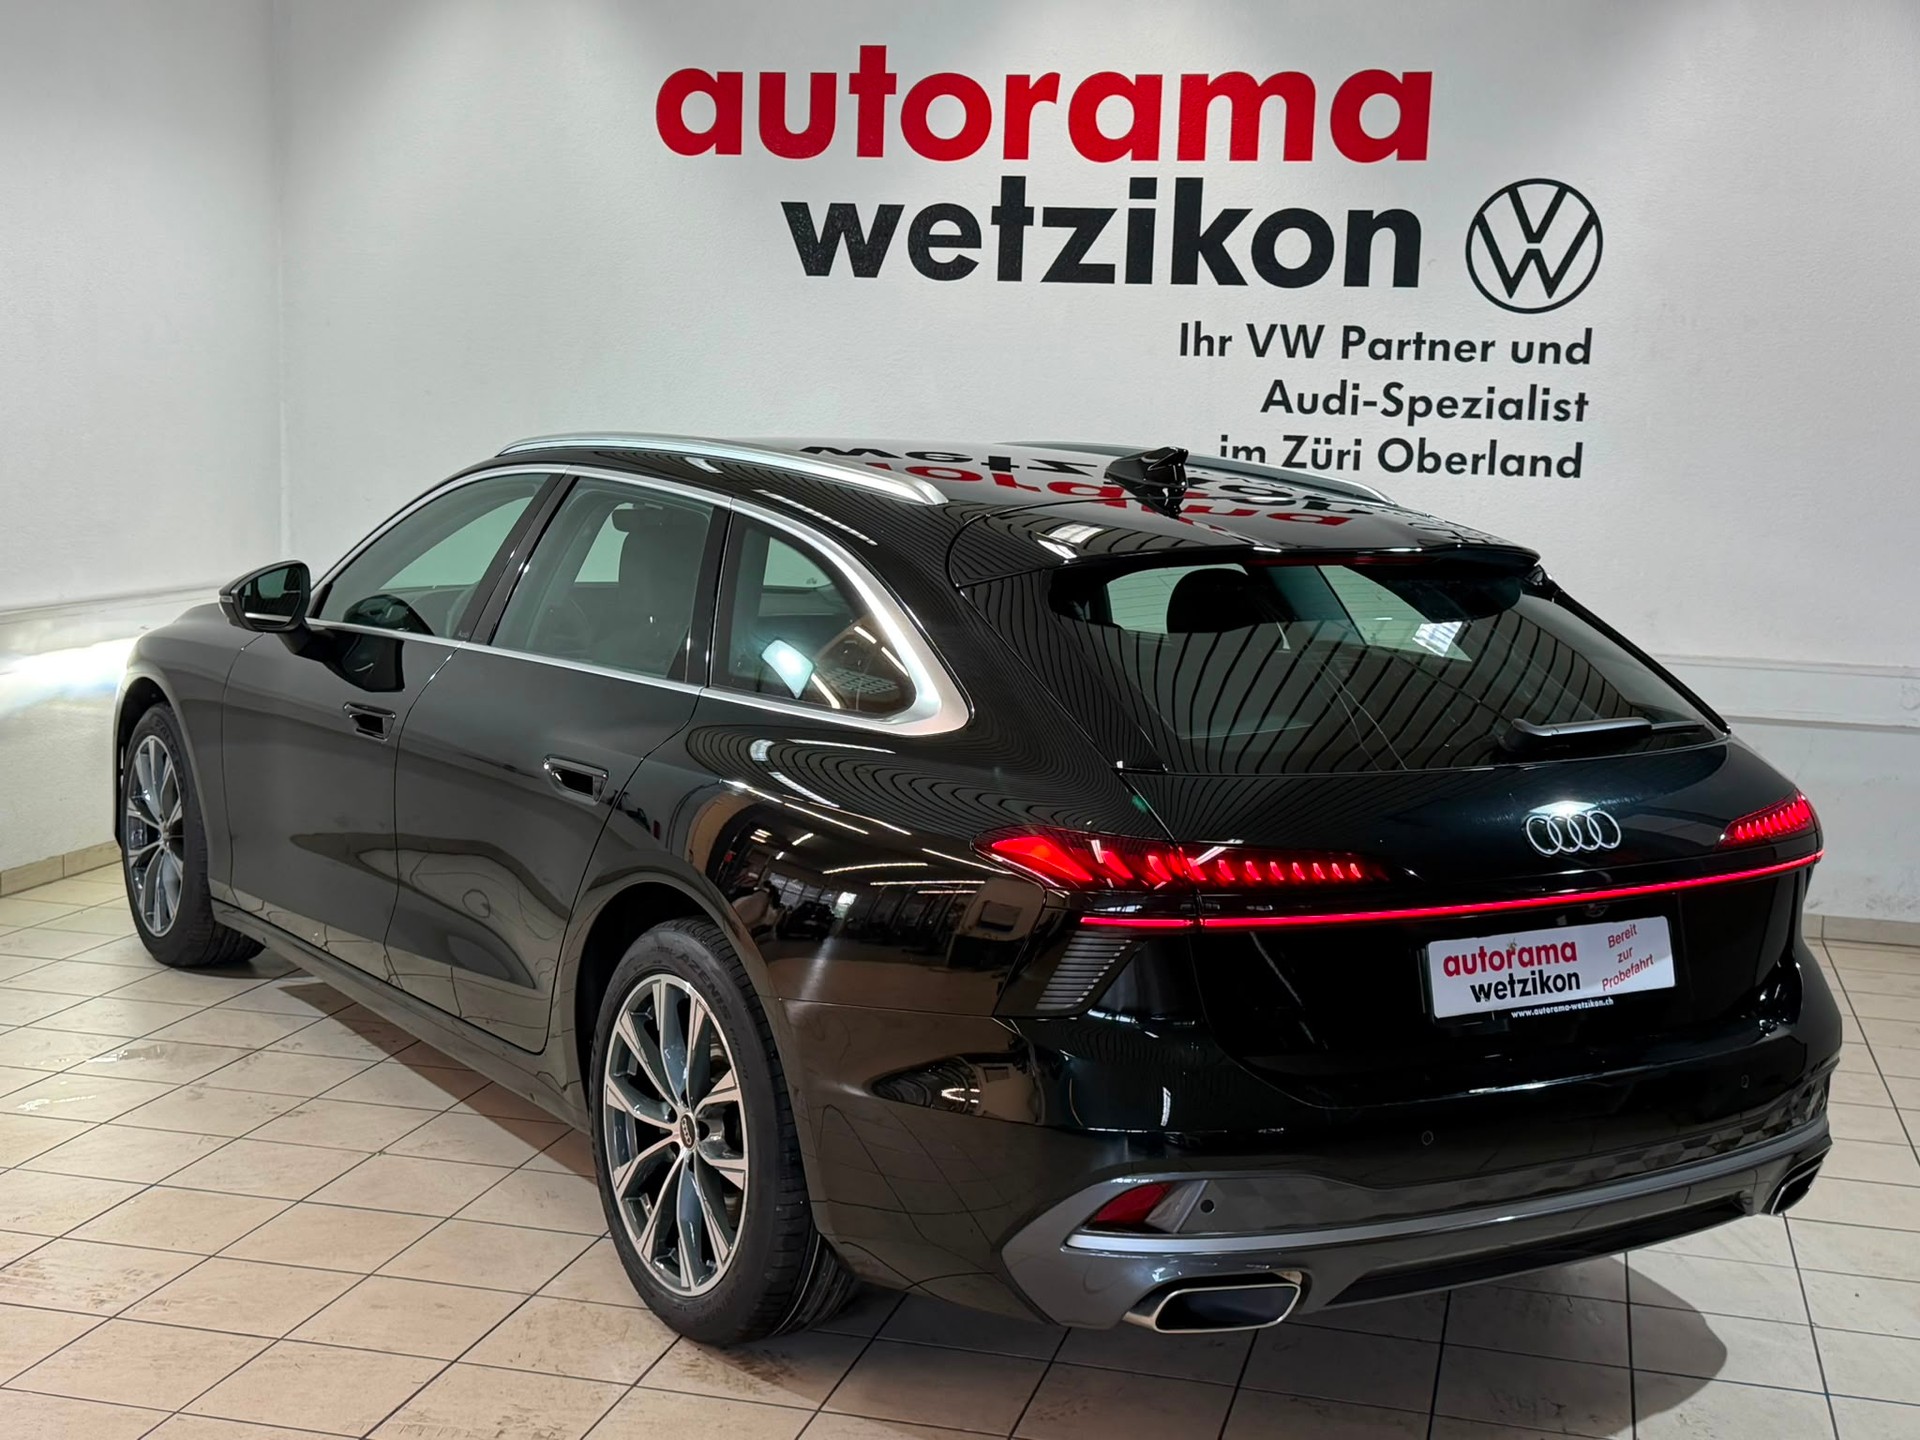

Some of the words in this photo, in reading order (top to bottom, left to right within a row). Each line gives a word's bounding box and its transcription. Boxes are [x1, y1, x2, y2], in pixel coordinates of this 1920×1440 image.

[656, 45, 1432, 164] autorama
[781, 175, 1421, 289] wetzikon
[1180, 321, 1233, 357] Ihr
[1246, 323, 1326, 359] VW
[1341, 325, 1496, 363] Partner
[1511, 327, 1593, 365] und
[1260, 379, 1589, 427] Audi-Spezialist
[1220, 433, 1266, 464] im
[1283, 434, 1362, 471] Züri
[1377, 437, 1583, 478] Oberland
[1607, 923, 1638, 949] Bereit
[1616, 945, 1634, 964] zur
[1442, 941, 1578, 977] autorama
[1601, 953, 1655, 992] Probefahrt
[1470, 970, 1581, 1003] wetzikon
[1511, 997, 1615, 1018] www.autorama-wetzikon.ch
